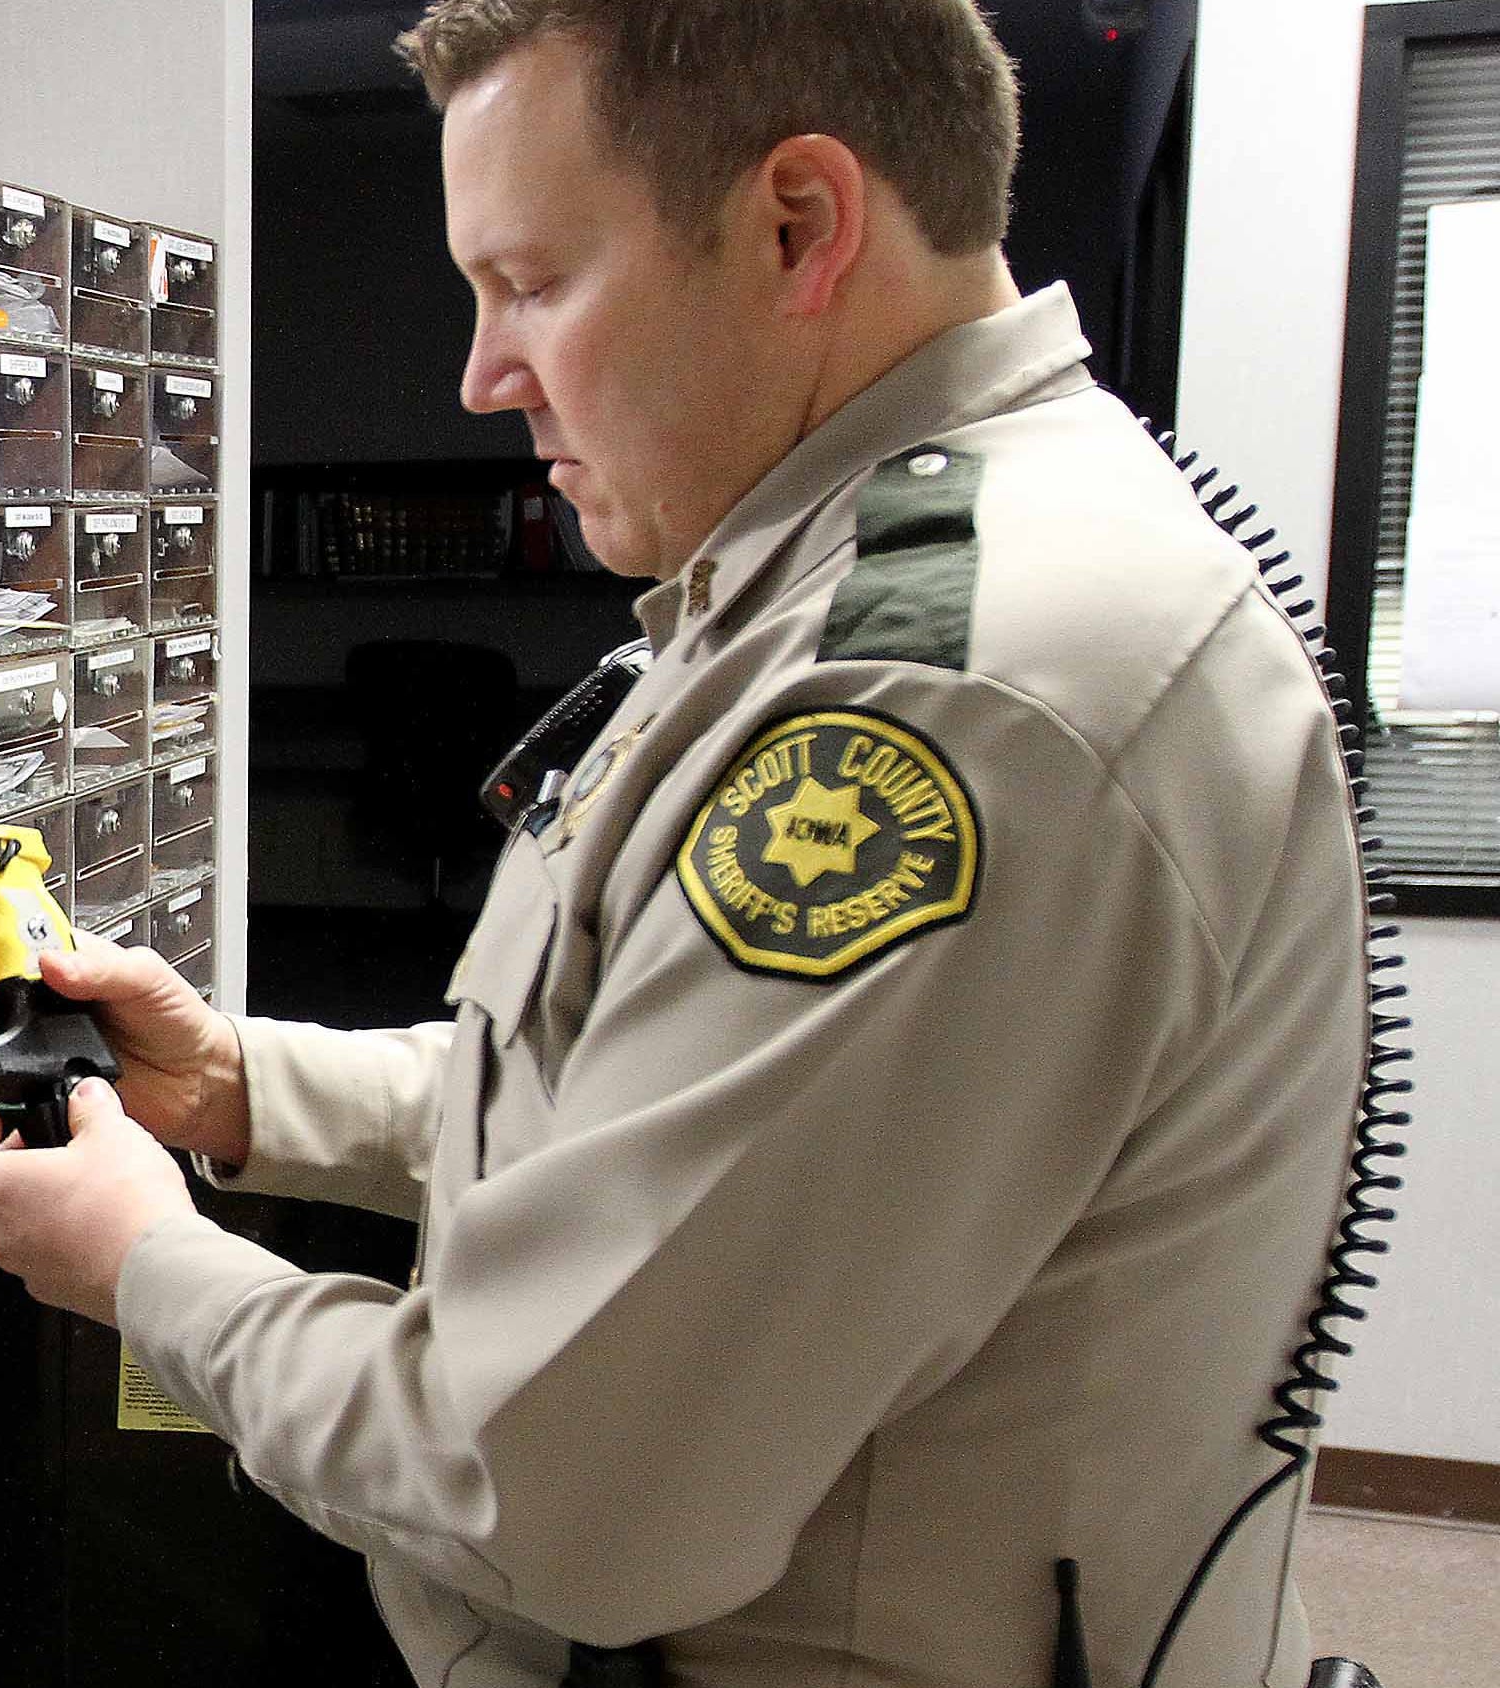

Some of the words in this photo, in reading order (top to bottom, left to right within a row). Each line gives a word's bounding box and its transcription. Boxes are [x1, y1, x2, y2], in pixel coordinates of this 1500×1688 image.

[719, 732, 818, 817] SCOTT
[838, 734, 956, 842] COUNTY
[786, 816, 848, 846] IOWA
[708, 824, 799, 935] SHERIFF'S
[807, 850, 936, 938] RESERVE
